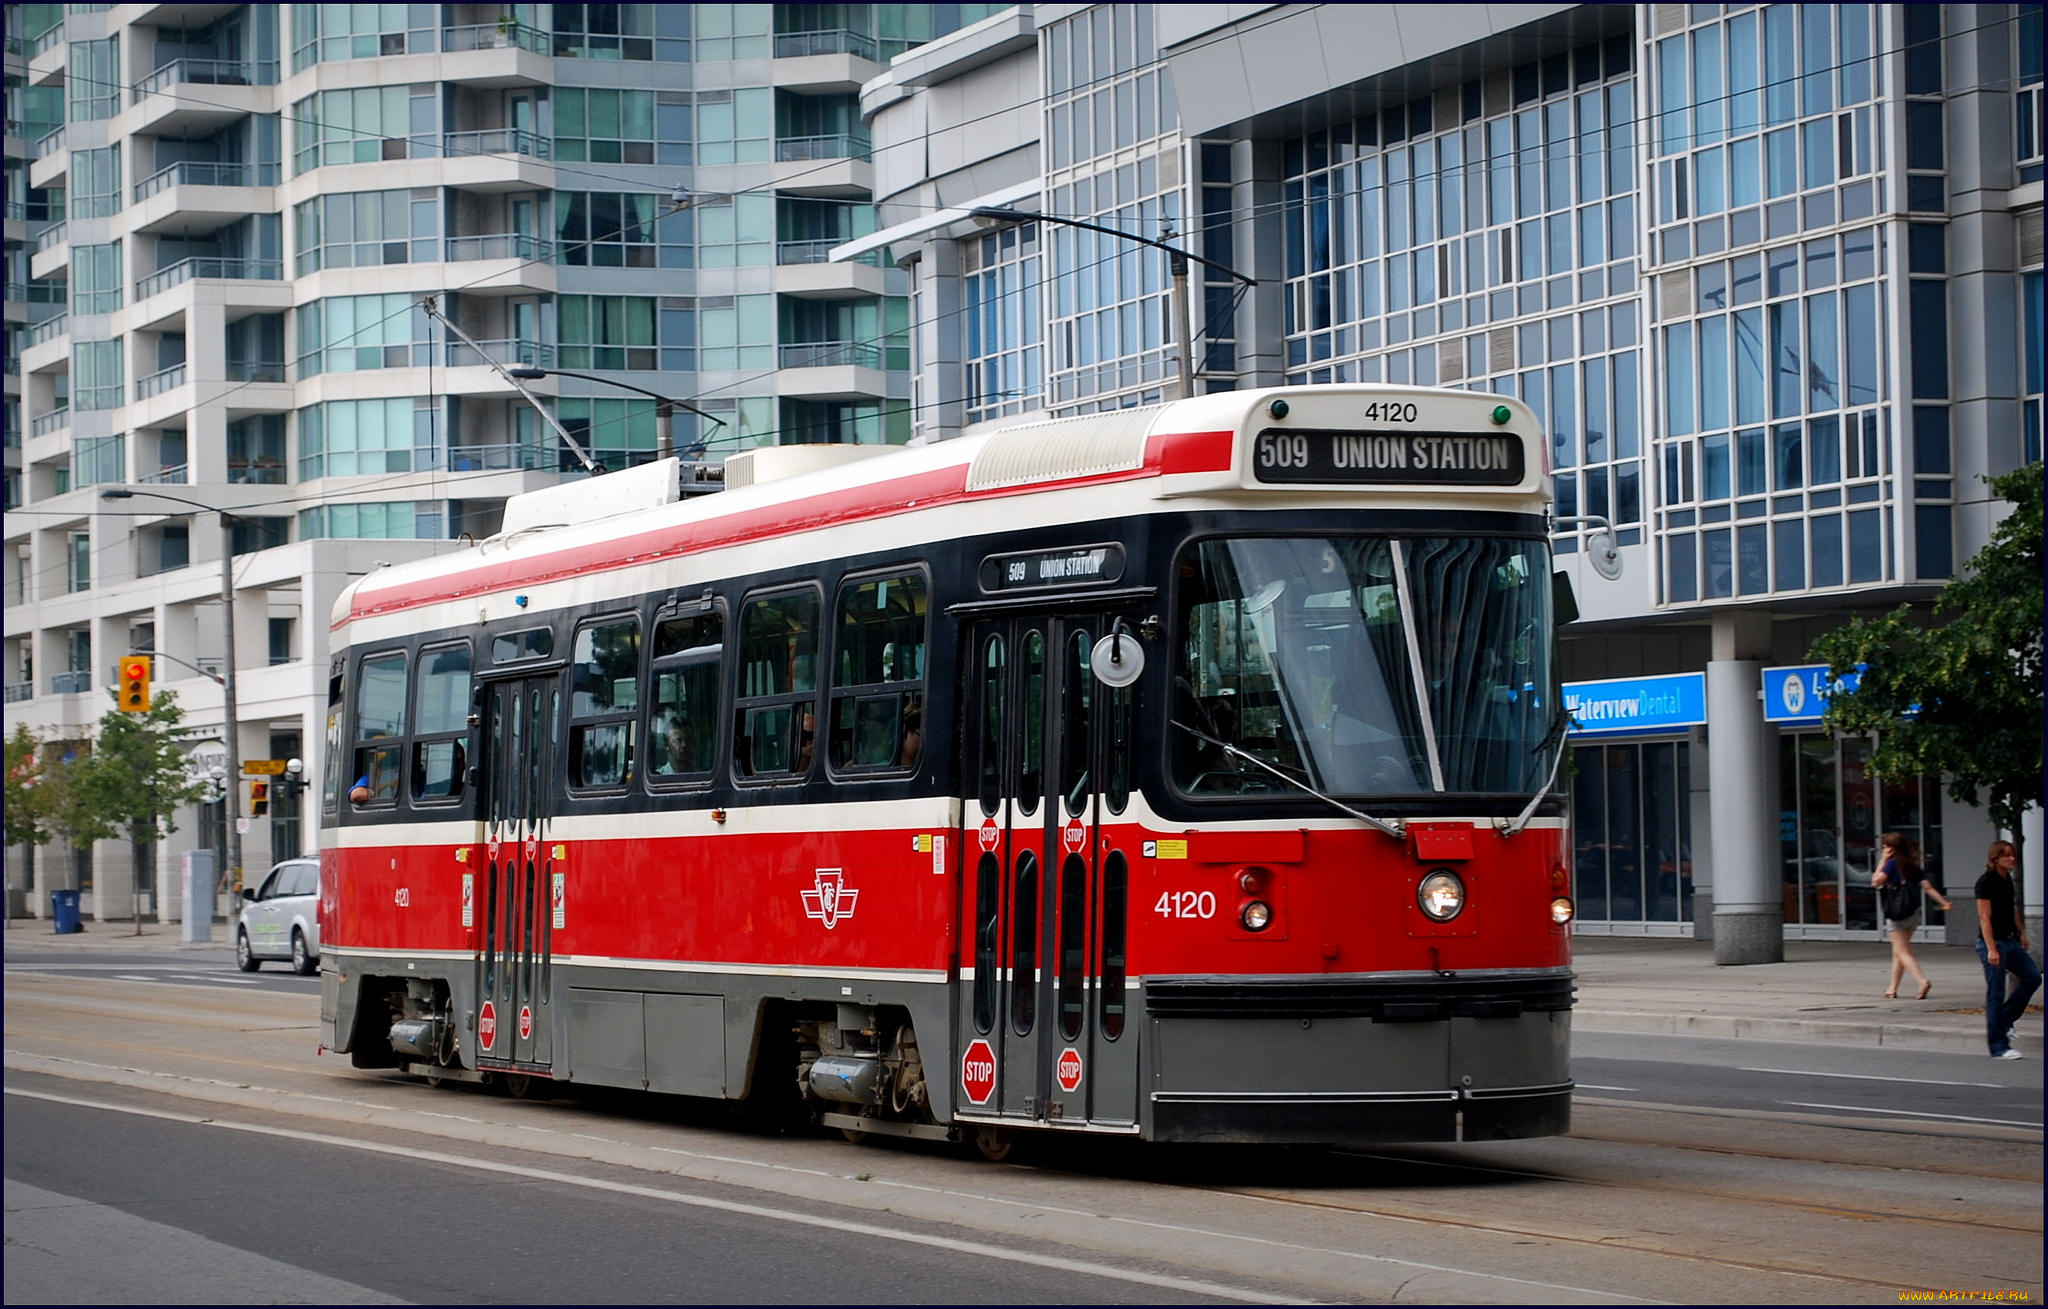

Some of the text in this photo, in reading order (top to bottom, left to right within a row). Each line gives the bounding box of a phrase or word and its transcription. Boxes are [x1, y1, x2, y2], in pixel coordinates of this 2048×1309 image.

[1365, 402, 1417, 423] 4120
[1260, 434, 1508, 470] 509 UNION STATION
[1008, 555, 1100, 581] 509 UNION STATION
[981, 828, 997, 842] STOP
[1066, 828, 1083, 842] STOP
[395, 888, 409, 907] 4120
[1154, 891, 1216, 919] 4120
[966, 1061, 992, 1083] STOP
[1060, 1061, 1079, 1079] STOP
